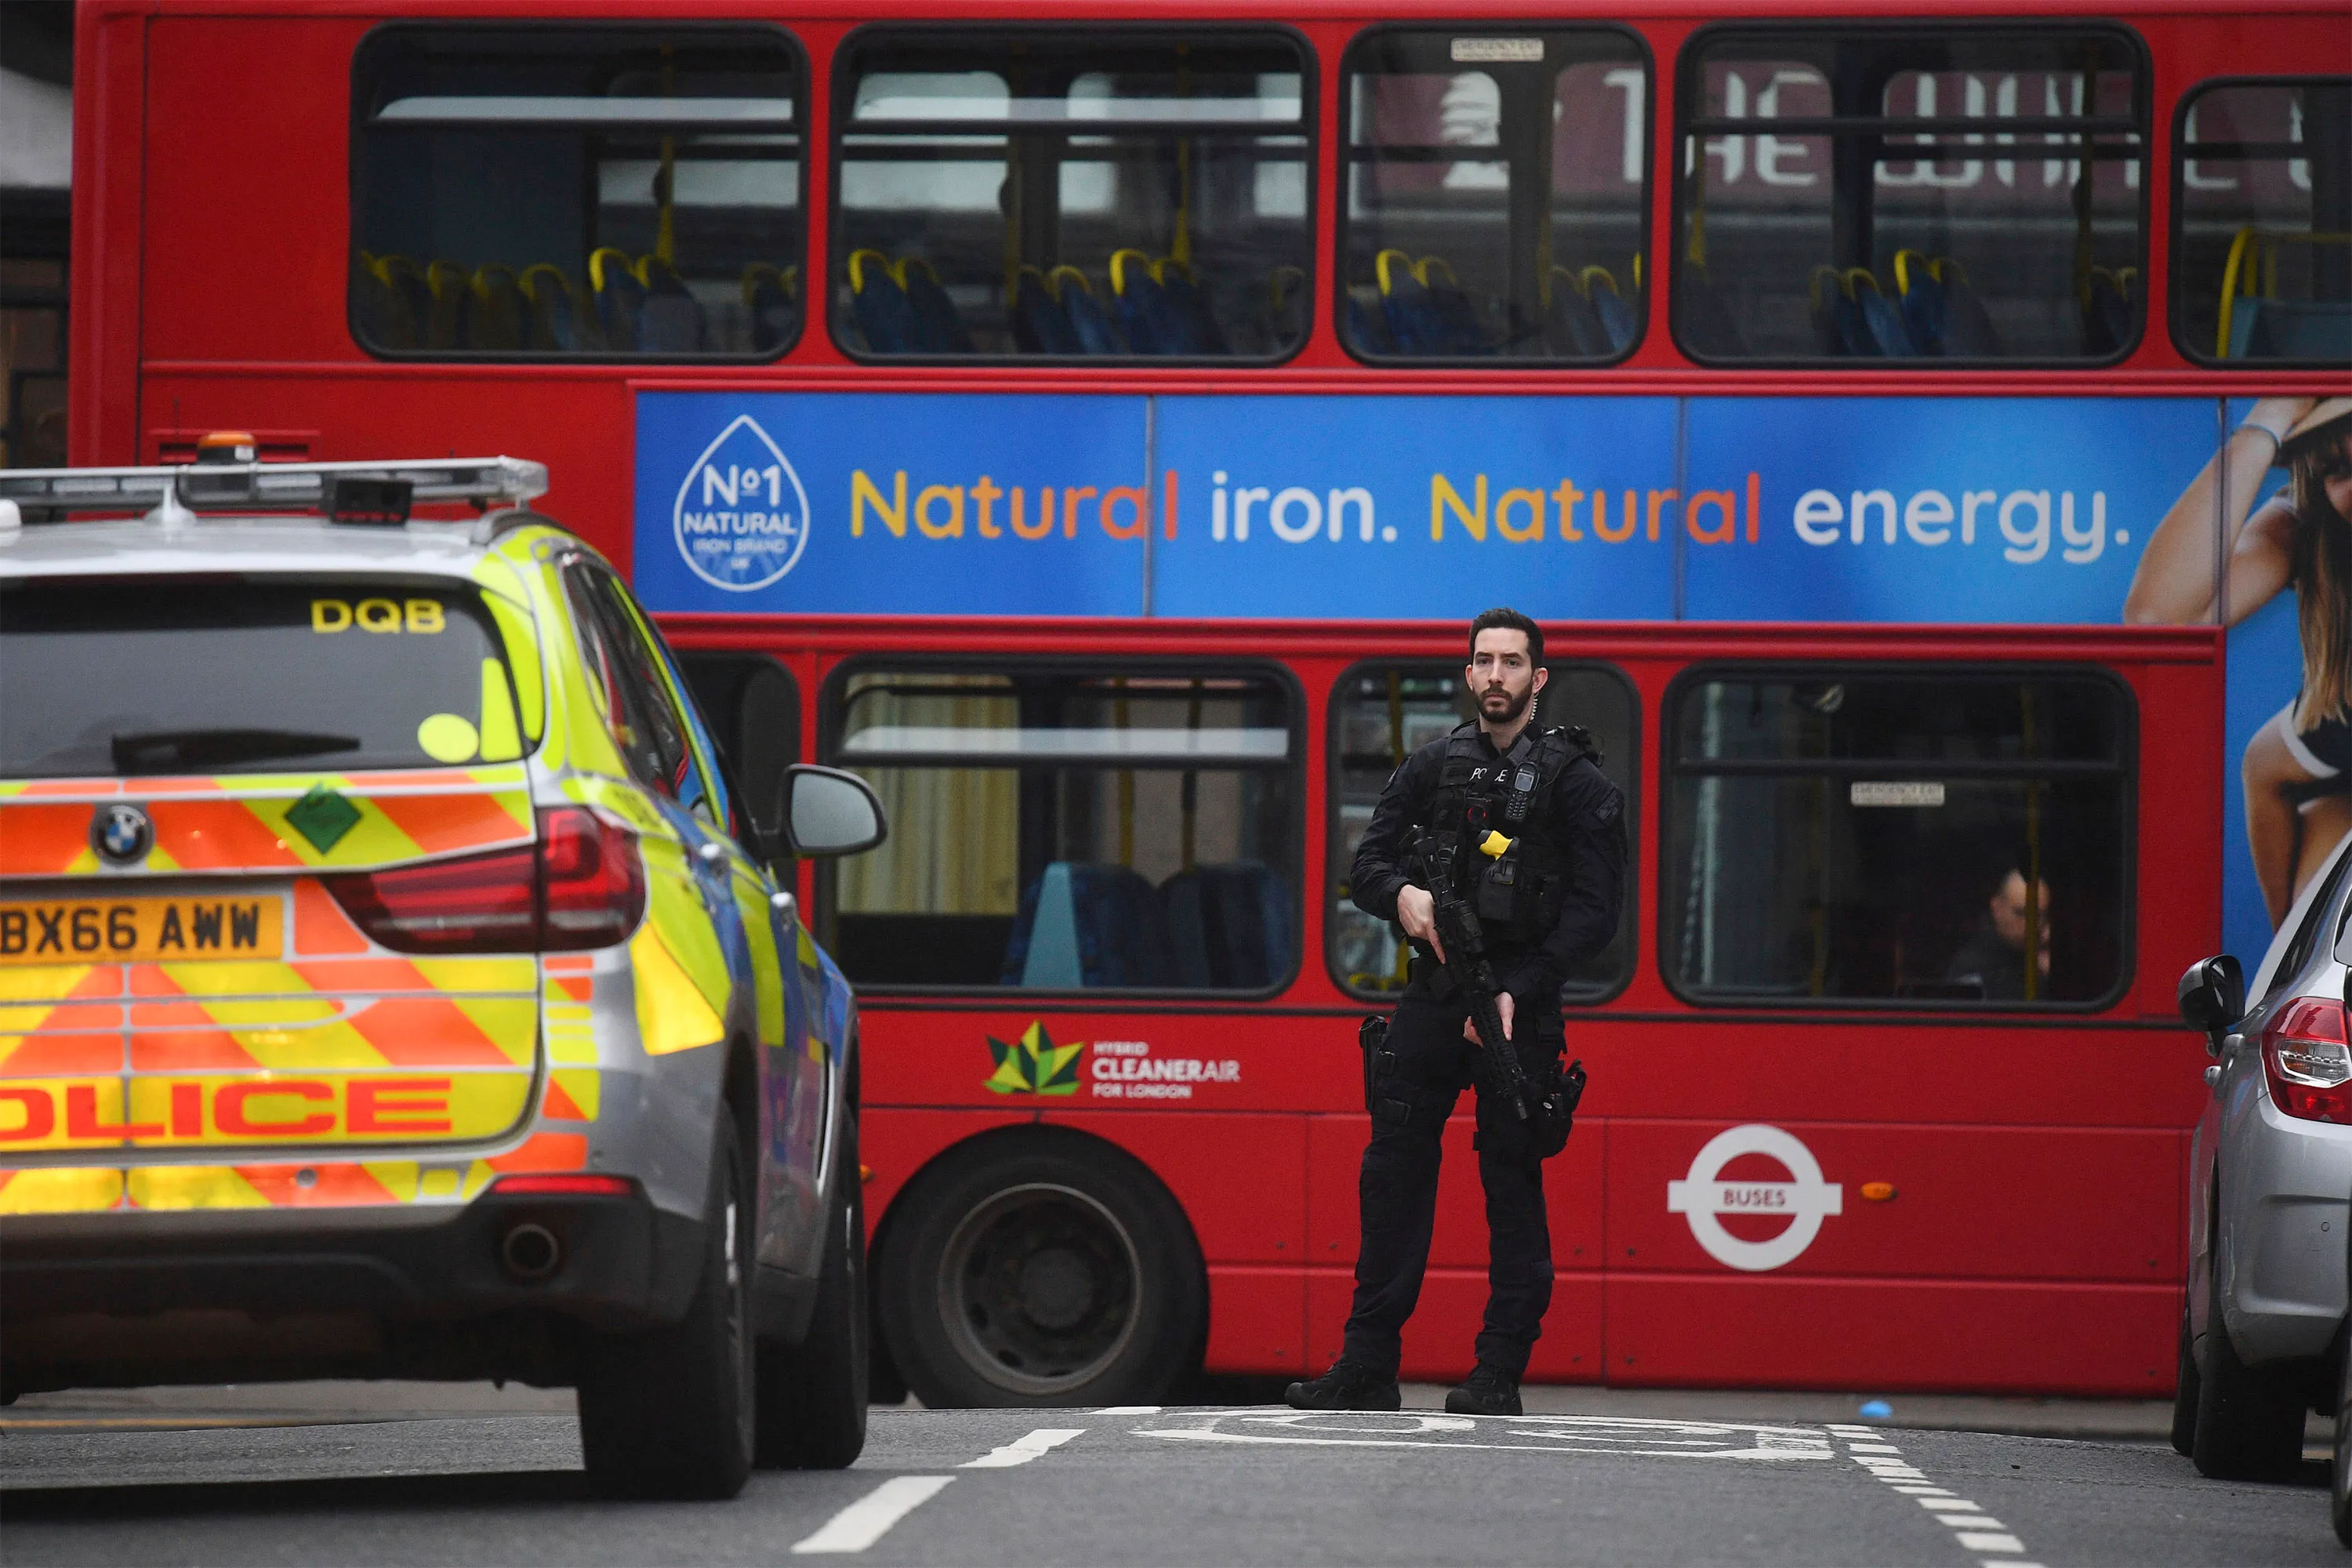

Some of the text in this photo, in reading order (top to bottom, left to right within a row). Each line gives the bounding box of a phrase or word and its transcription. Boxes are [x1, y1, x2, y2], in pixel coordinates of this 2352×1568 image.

[683, 511, 798, 535] NATURAL
[851, 470, 2129, 564] Natural iron. Natural energy.
[310, 597, 446, 634] DQB
[0, 902, 260, 954] BX66 AWW
[1092, 1082, 1193, 1099] FOR LONDON
[1723, 1188, 1787, 1207] BUSES
